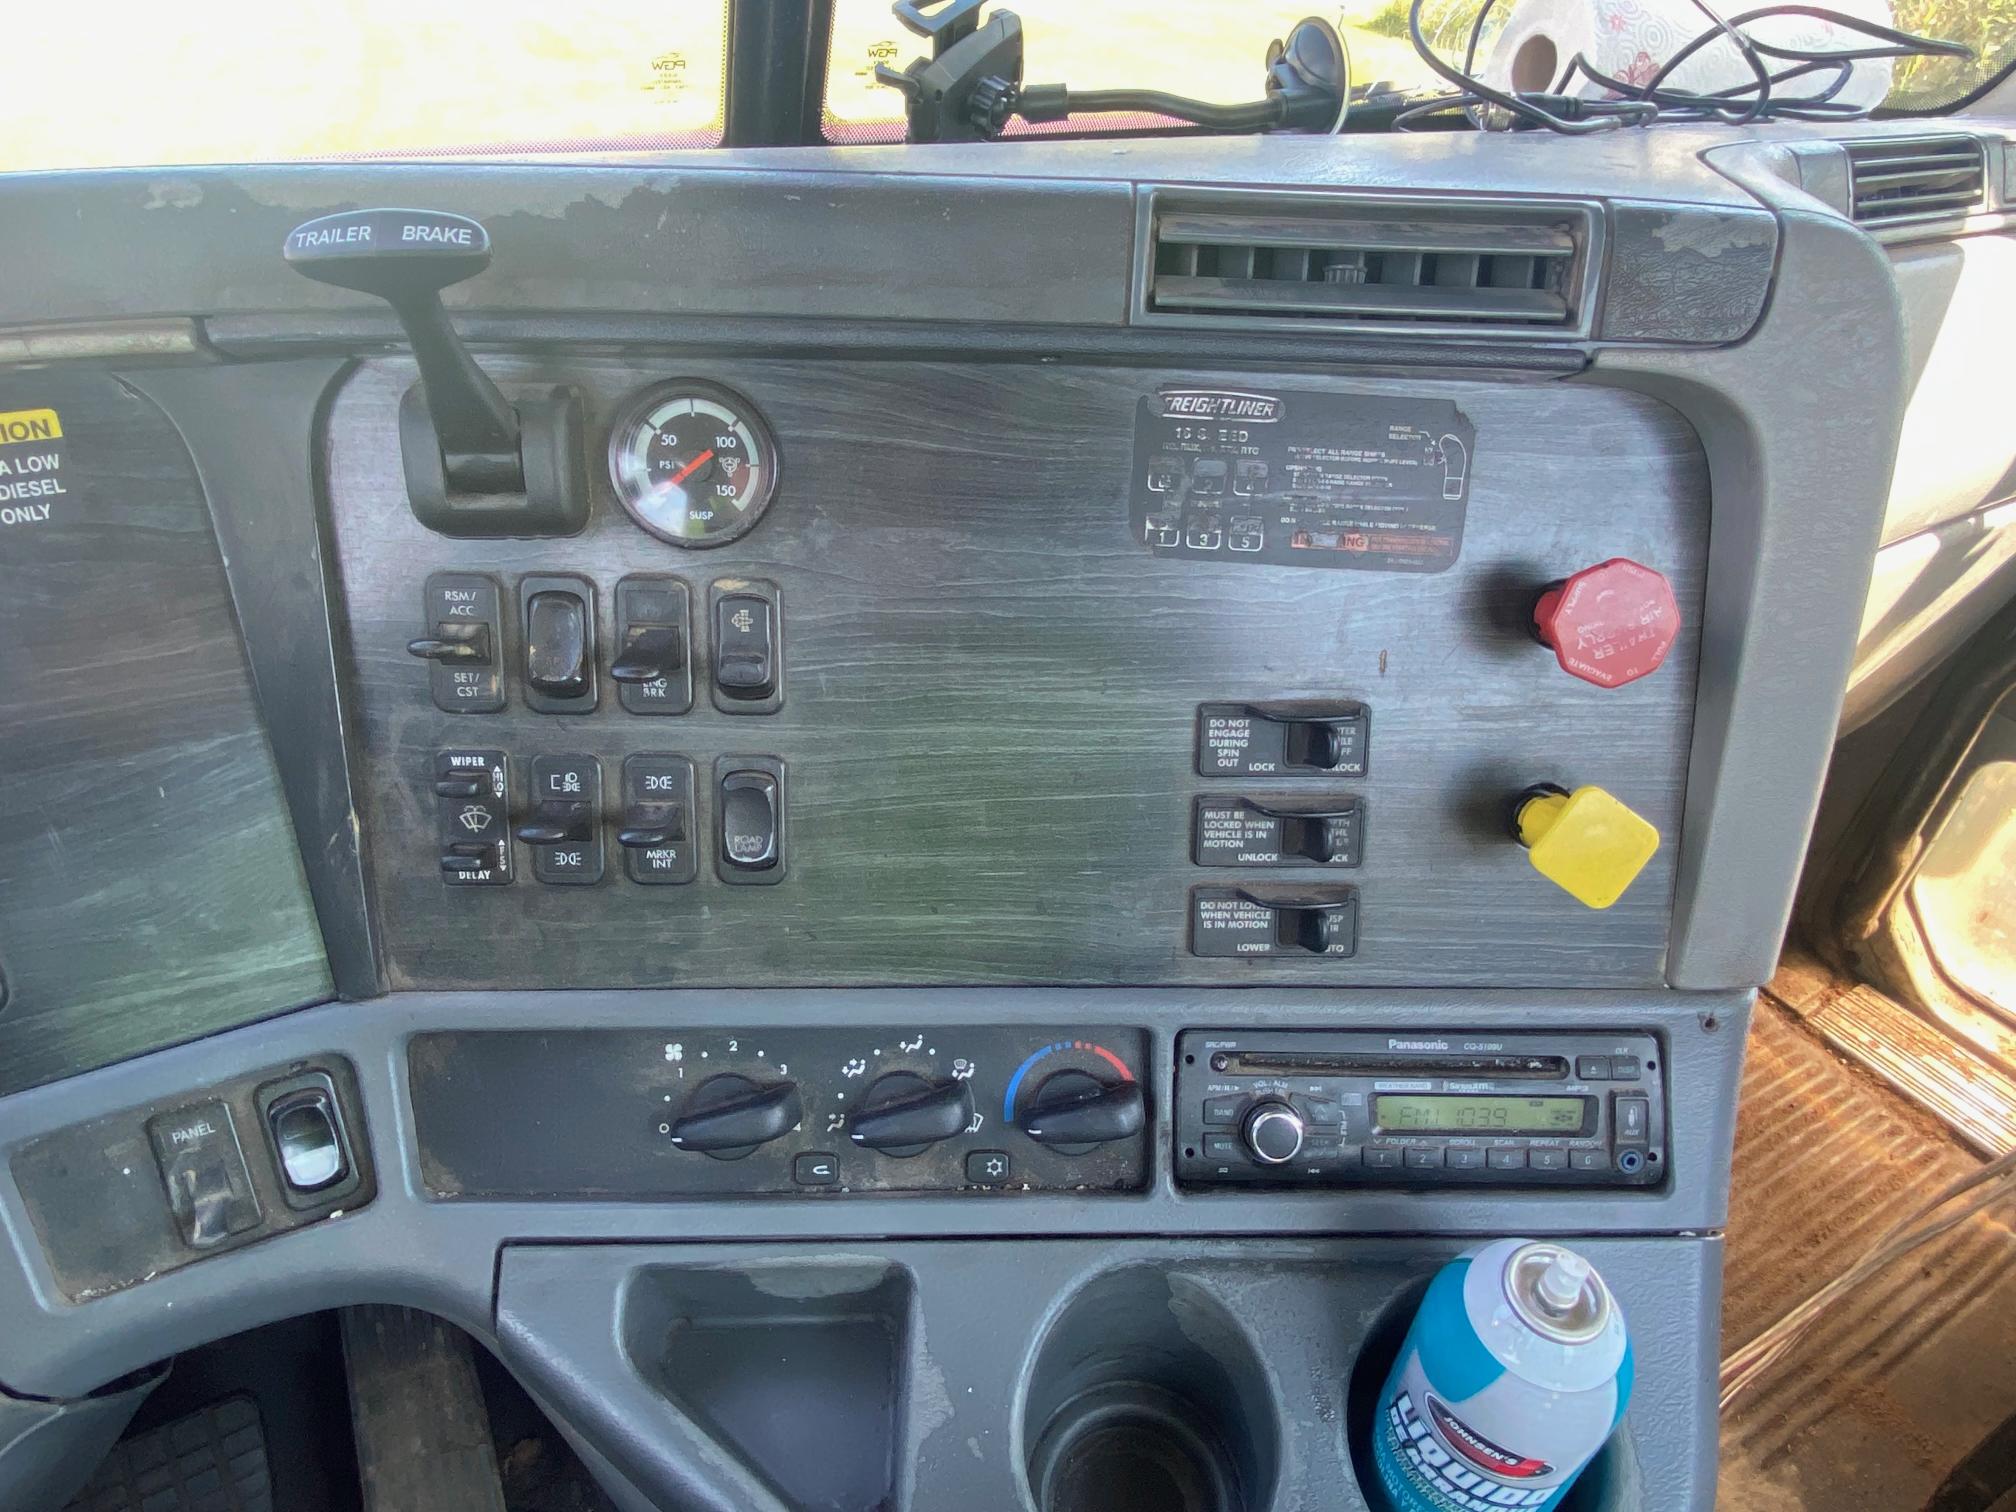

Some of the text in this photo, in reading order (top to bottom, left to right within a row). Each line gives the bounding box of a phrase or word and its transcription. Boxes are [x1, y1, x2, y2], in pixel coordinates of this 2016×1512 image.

[296, 224, 472, 248] TRAILER BRAKE
[1165, 396, 1274, 417] FREIGHTLINER
[660, 434, 677, 446] 50
[716, 436, 736, 448] 100
[15, 454, 60, 474] LOW
[659, 460, 674, 469] PSI
[0, 479, 67, 500] DIESEL
[716, 485, 736, 496] 150
[1, 503, 50, 524] ONLY
[689, 511, 714, 520] SUSP
[1200, 533, 1209, 545] 3
[1241, 536, 1250, 548] 5
[449, 605, 474, 616] ACC
[456, 686, 479, 697] CST
[642, 688, 666, 698] BRK
[1209, 719, 1250, 728] DO NOT
[1208, 729, 1250, 738] ENGAGE
[1209, 738, 1249, 748] DURING
[1217, 748, 1240, 757] SPIN
[451, 756, 486, 767] WIPER
[1218, 758, 1239, 767] OUT
[1248, 762, 1275, 772] LOCK
[1322, 763, 1361, 772] LOCK
[1204, 811, 1245, 820] MUST BE
[1204, 820, 1275, 829] LOCKED WHEN
[1203, 830, 1267, 839] VEHICLE IS IN
[1203, 840, 1244, 849] MOTION
[647, 849, 677, 859] MRKR
[1237, 853, 1278, 862] UNLOCK
[653, 859, 674, 869] INT
[459, 870, 491, 880] DELAY
[1200, 901, 1215, 910] DO
[1217, 901, 1238, 910] NOT
[1200, 911, 1271, 920] WHEN VEHICLE
[1203, 920, 1268, 929] IS IN MOTION
[1237, 943, 1270, 952] LOWER
[729, 1040, 738, 1051] 2
[1388, 1038, 1449, 1050] Panasonic
[678, 1067, 684, 1079] 1
[780, 1064, 788, 1076] 3
[172, 1122, 216, 1144] PANEL
[1443, 1416, 1519, 1467] JOHNSEN'S
